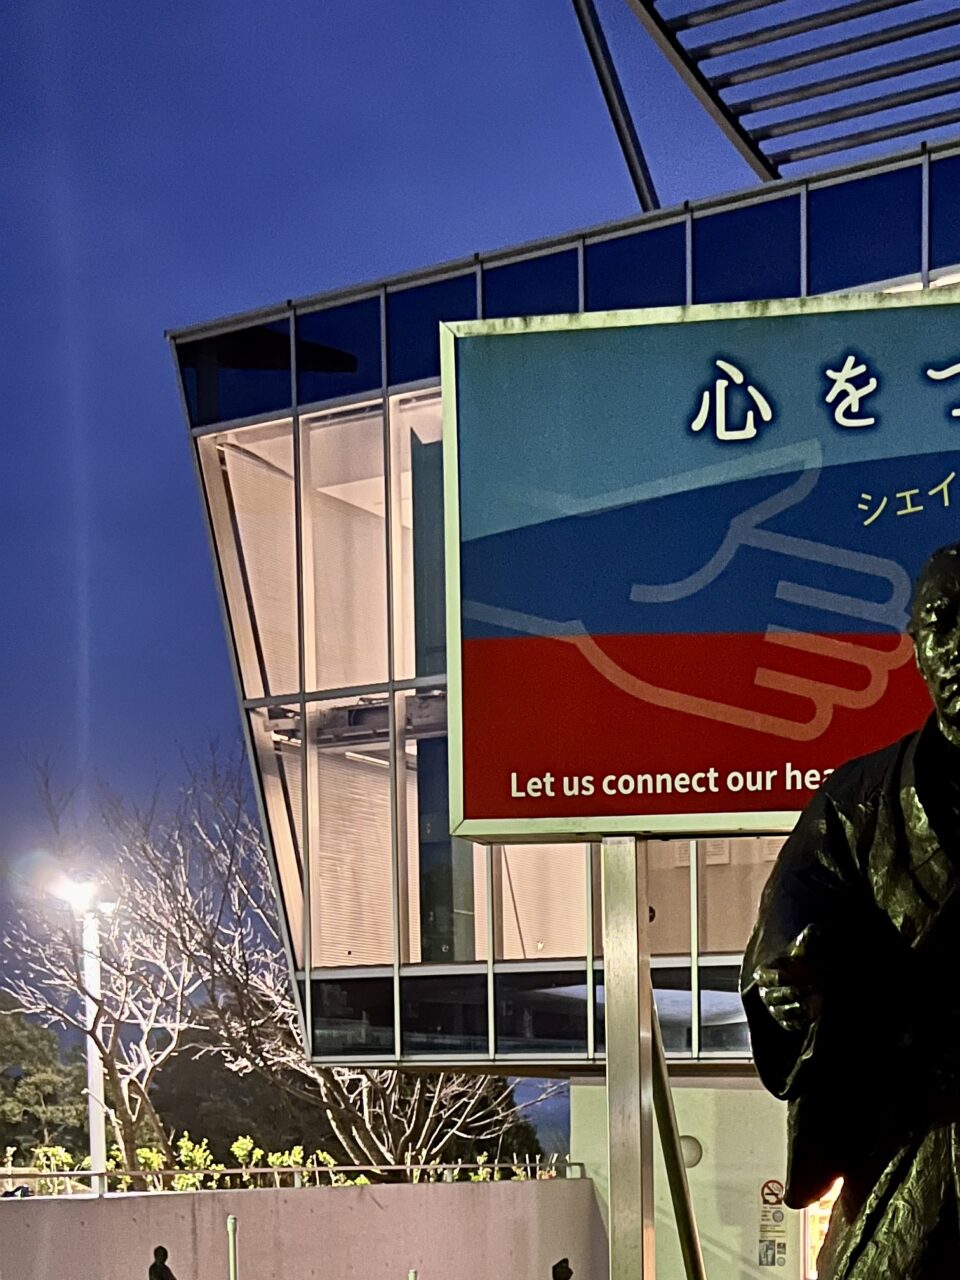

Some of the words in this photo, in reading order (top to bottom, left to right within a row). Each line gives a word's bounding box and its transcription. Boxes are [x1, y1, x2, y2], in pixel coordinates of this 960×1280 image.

[511, 771, 555, 798] Let
[562, 773, 595, 796] us
[602, 767, 719, 794] connect
[727, 768, 778, 792] our
